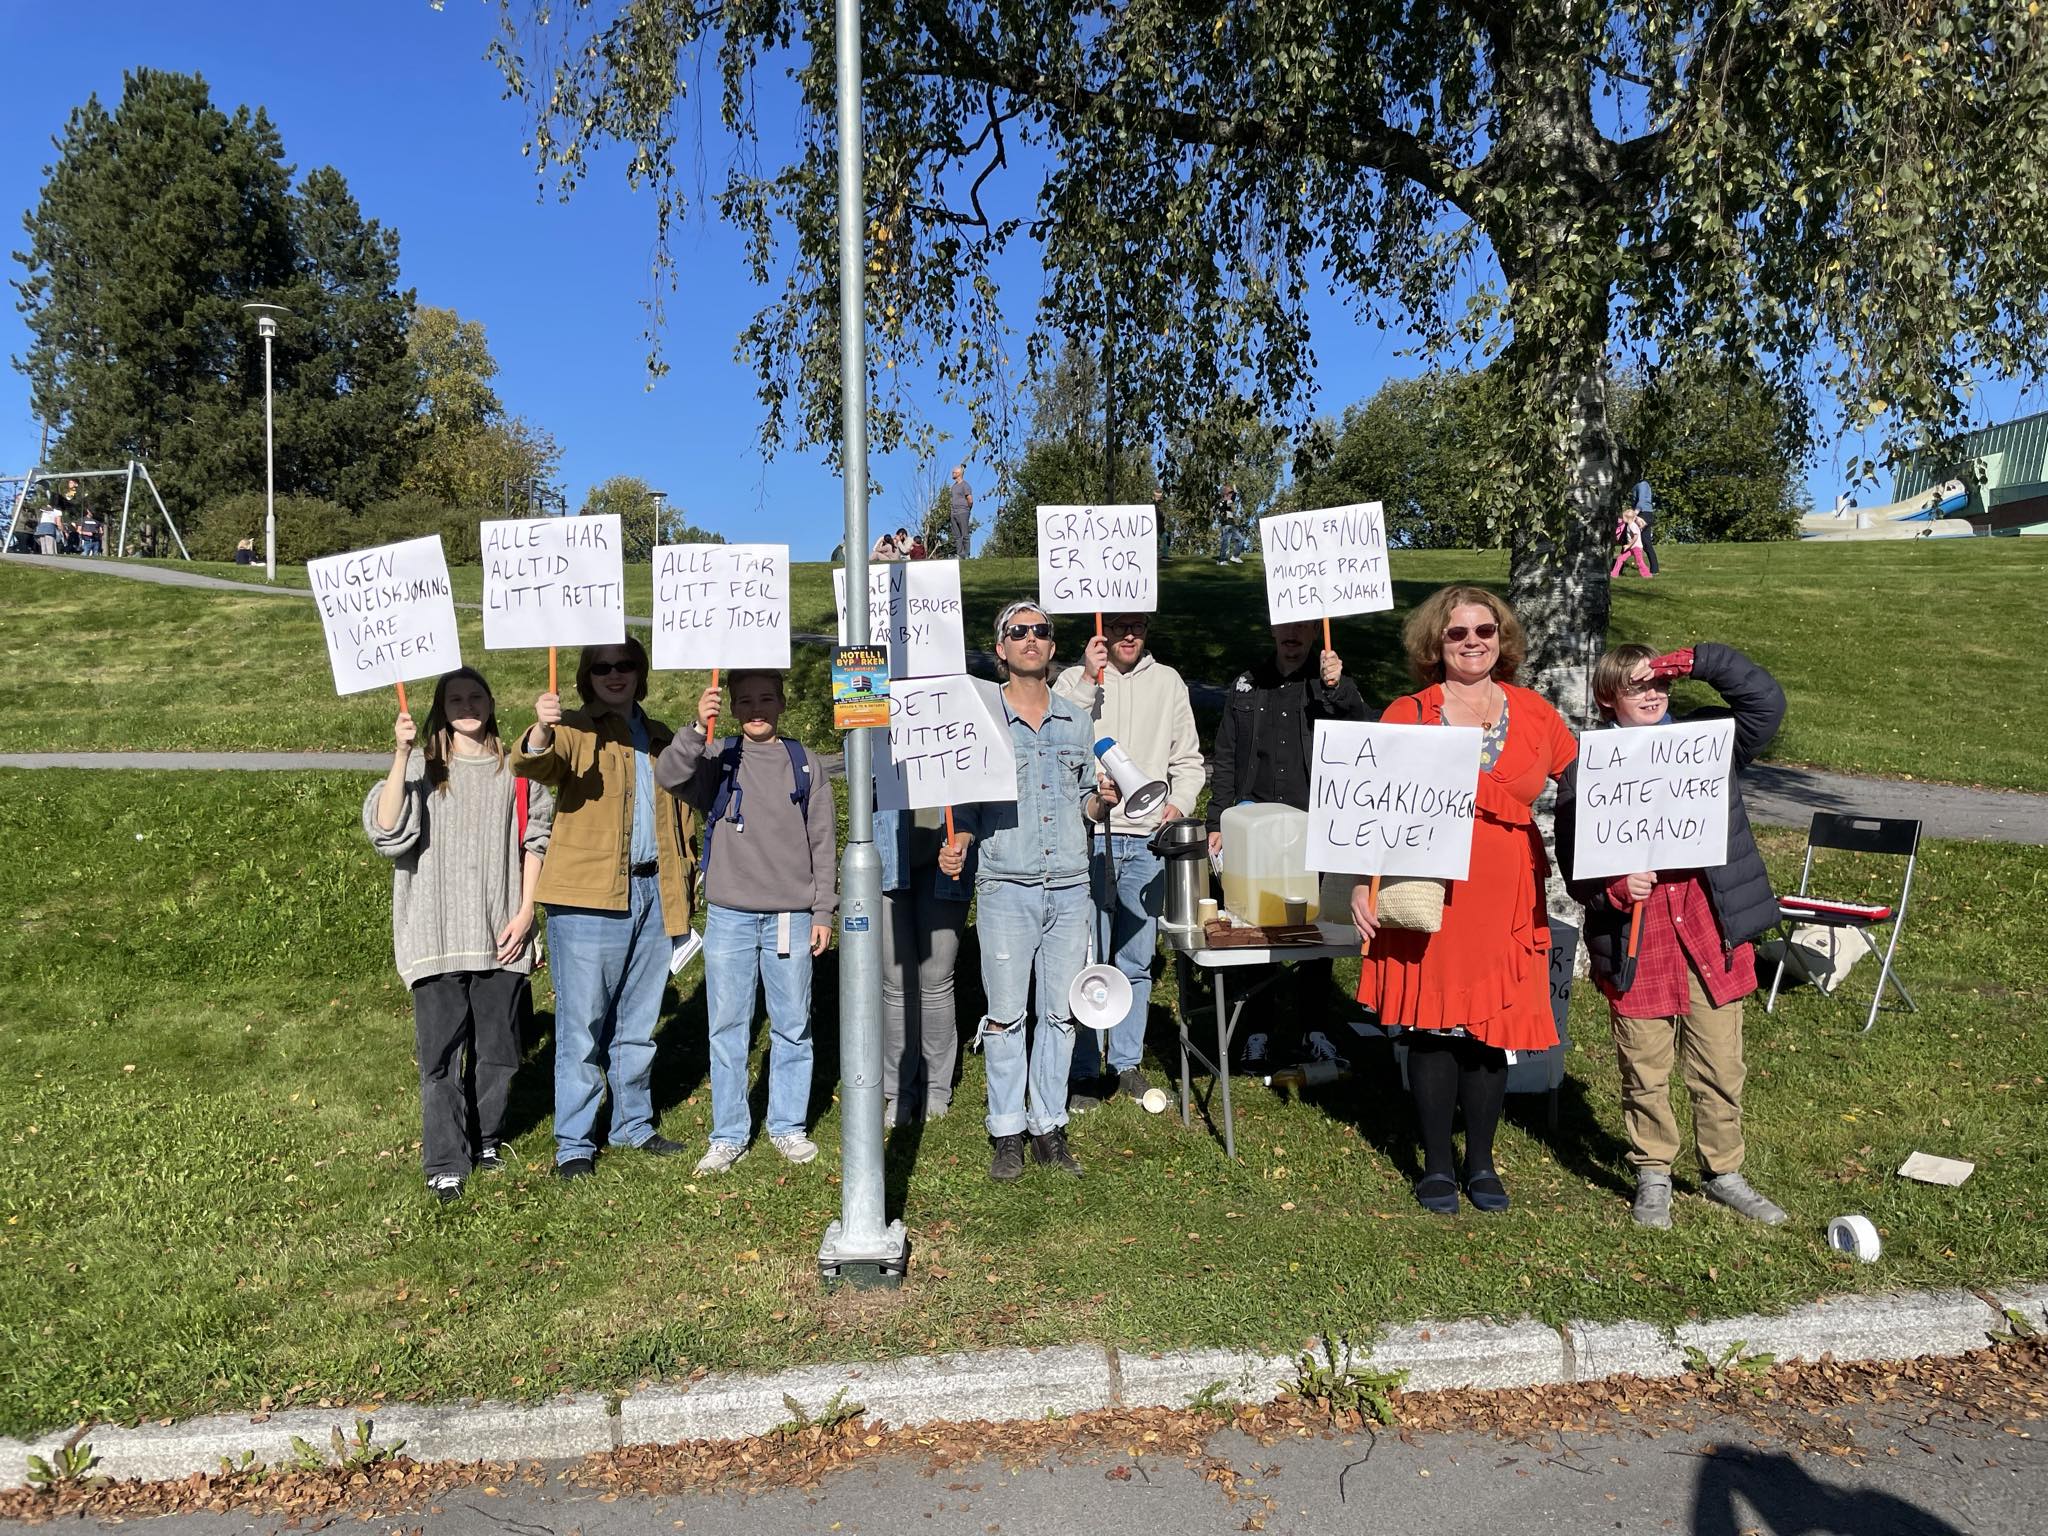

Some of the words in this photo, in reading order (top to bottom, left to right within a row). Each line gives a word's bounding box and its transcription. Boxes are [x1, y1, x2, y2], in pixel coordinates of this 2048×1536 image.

[487, 522, 551, 552] ALLE
[566, 522, 608, 550] HAR
[1045, 509, 1154, 541] GRÅSAND
[1271, 517, 1318, 552] NOK
[1323, 519, 1338, 534] ER
[1340, 508, 1380, 548] NOK
[316, 551, 395, 592] INGEN
[491, 555, 569, 581] ALLTID
[661, 550, 714, 577] ALLE
[730, 552, 775, 577] TAR
[1050, 546, 1085, 569] ER
[1102, 546, 1141, 573] FOR
[1273, 560, 1327, 580] MINDRE
[1337, 556, 1381, 574] PRAT
[322, 577, 449, 618] ENVEISKJØRING
[490, 583, 555, 611] LITT
[562, 582, 621, 610] RETT!
[659, 581, 718, 604] LITT
[729, 579, 779, 600] FEIL
[841, 569, 903, 600] IEN
[1054, 577, 1148, 600] GRUNN!
[1277, 584, 1324, 609] MER
[1332, 581, 1385, 603] SNAKK!
[661, 607, 717, 632] HELE
[727, 606, 782, 630] TIDEN
[908, 598, 961, 616] BRUER
[333, 631, 339, 650] I
[348, 615, 398, 646] VÅRE
[899, 624, 929, 645] BY!
[356, 632, 436, 671] GATER!
[841, 651, 876, 659] HOTELL
[1321, 731, 1378, 768] LA
[1586, 744, 1628, 770] LA
[1651, 729, 1729, 765] INGEN
[1318, 775, 1475, 818] INGAKIOSKEN
[1587, 777, 1664, 808] GATE
[1669, 776, 1725, 800] VÆRE
[1328, 819, 1434, 851] LEVE!
[1596, 815, 1706, 846] UGRAVD!
